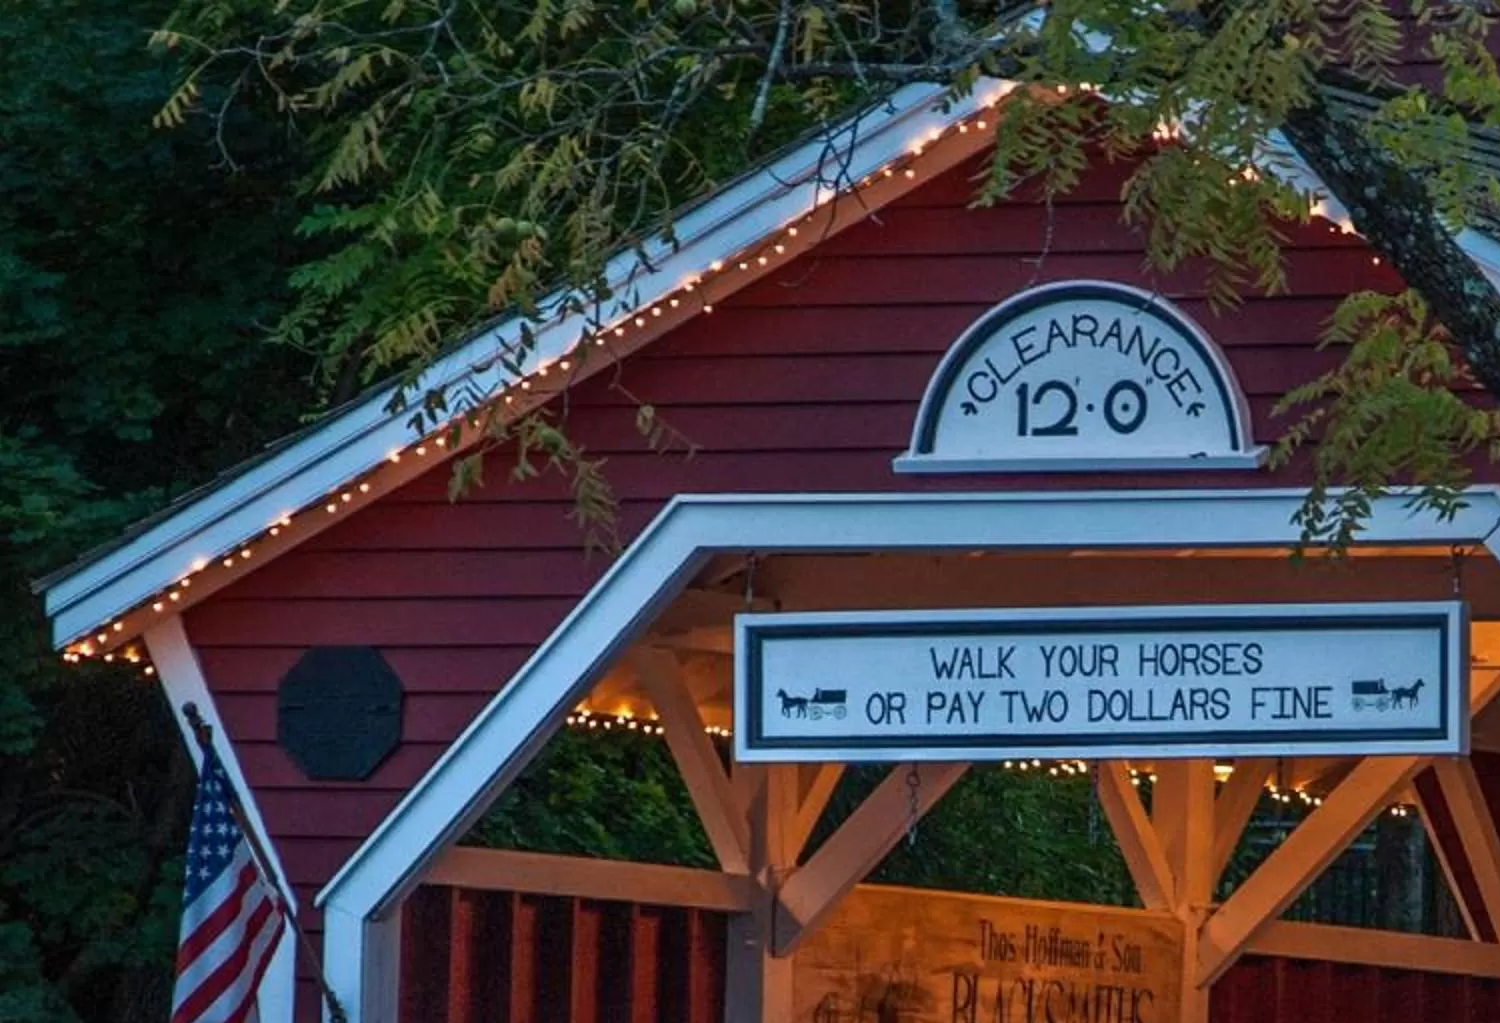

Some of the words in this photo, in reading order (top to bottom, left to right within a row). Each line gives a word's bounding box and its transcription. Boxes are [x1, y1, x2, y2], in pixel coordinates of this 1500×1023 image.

[966, 313, 1203, 408] CLEARANCE
[929, 646, 1016, 680] WALK
[1039, 644, 1119, 678] YOUR
[1139, 642, 1264, 677] HORSES
[865, 691, 907, 726] OR
[926, 690, 986, 725] PAY
[999, 689, 1069, 724] TWO
[1087, 687, 1231, 723] DOLLARS
[1251, 685, 1334, 721] FINE
[1110, 933, 1142, 974] Son
